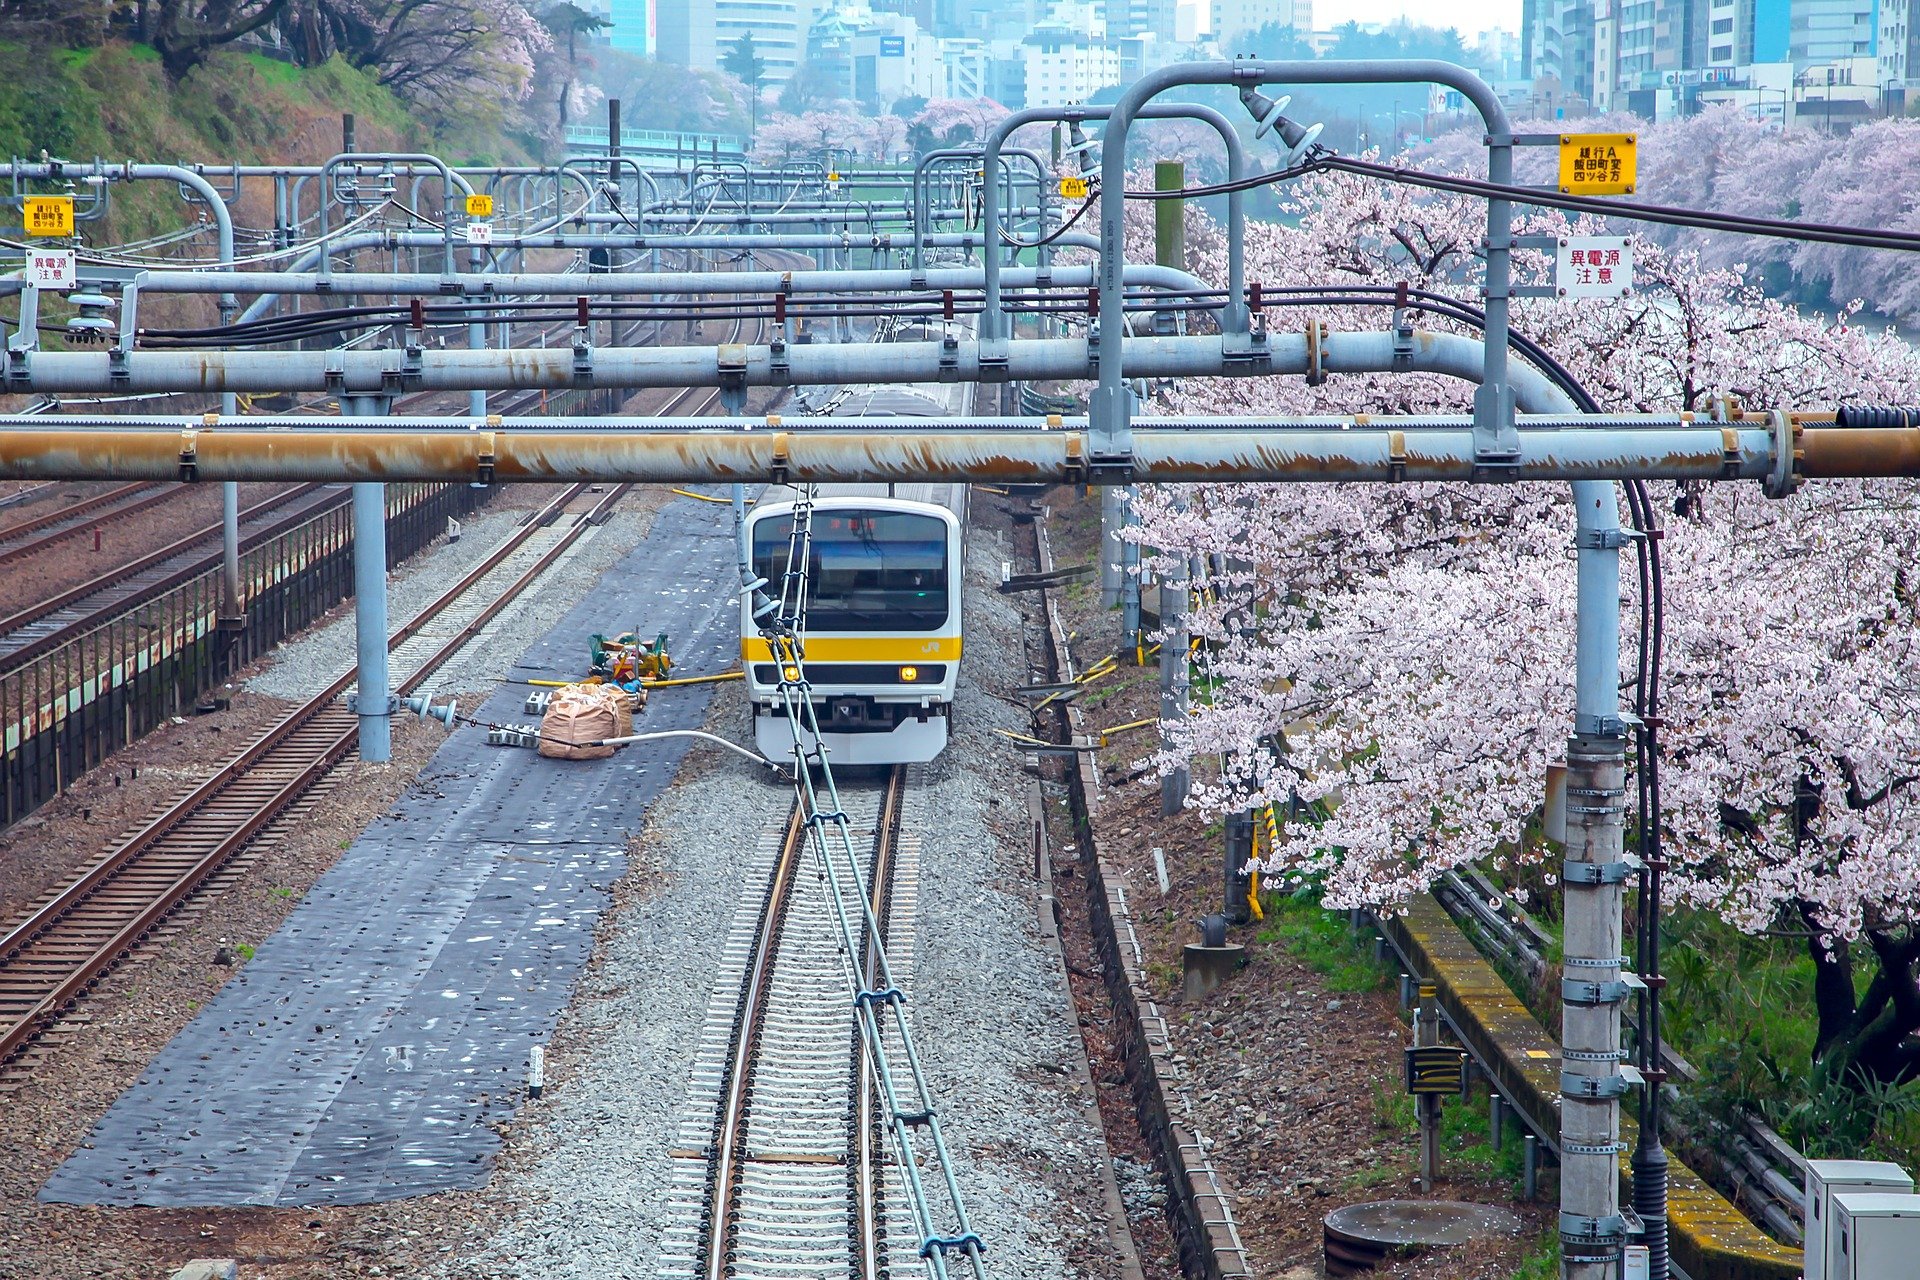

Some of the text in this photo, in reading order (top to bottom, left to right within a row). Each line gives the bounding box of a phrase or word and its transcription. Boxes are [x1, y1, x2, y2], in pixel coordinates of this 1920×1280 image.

[1579, 146, 1617, 159] 緩行A
[1573, 158, 1622, 171] 飯田町変
[1573, 170, 1620, 182] 四ツ谷方
[1569, 249, 1621, 267] 異電源
[38, 269, 63, 280] 注意
[1576, 267, 1613, 285] 注意
[921, 641, 940, 654] JR
